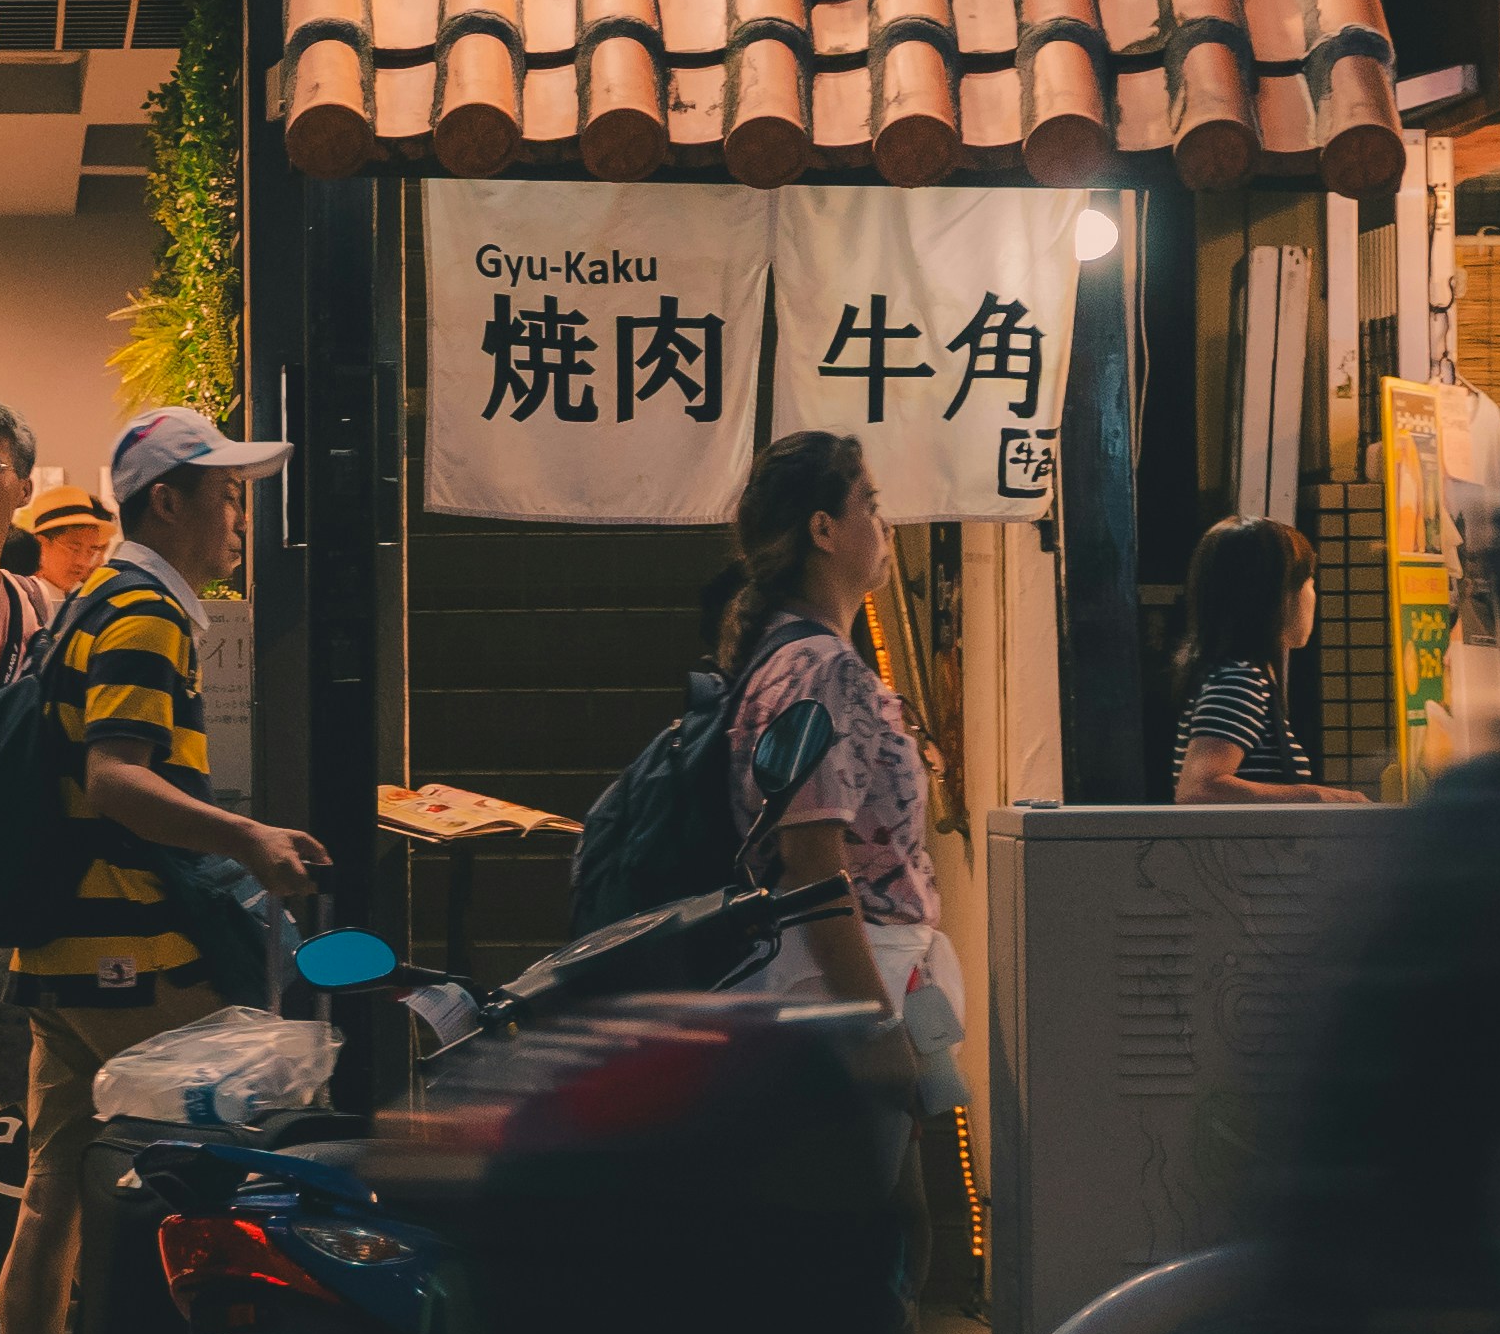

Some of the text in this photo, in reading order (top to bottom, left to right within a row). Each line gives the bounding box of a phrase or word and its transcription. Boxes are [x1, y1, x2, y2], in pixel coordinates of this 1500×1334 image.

[475, 244, 658, 287] Gyu-Kaku
[481, 291, 1047, 424] 焼肉 牛角
